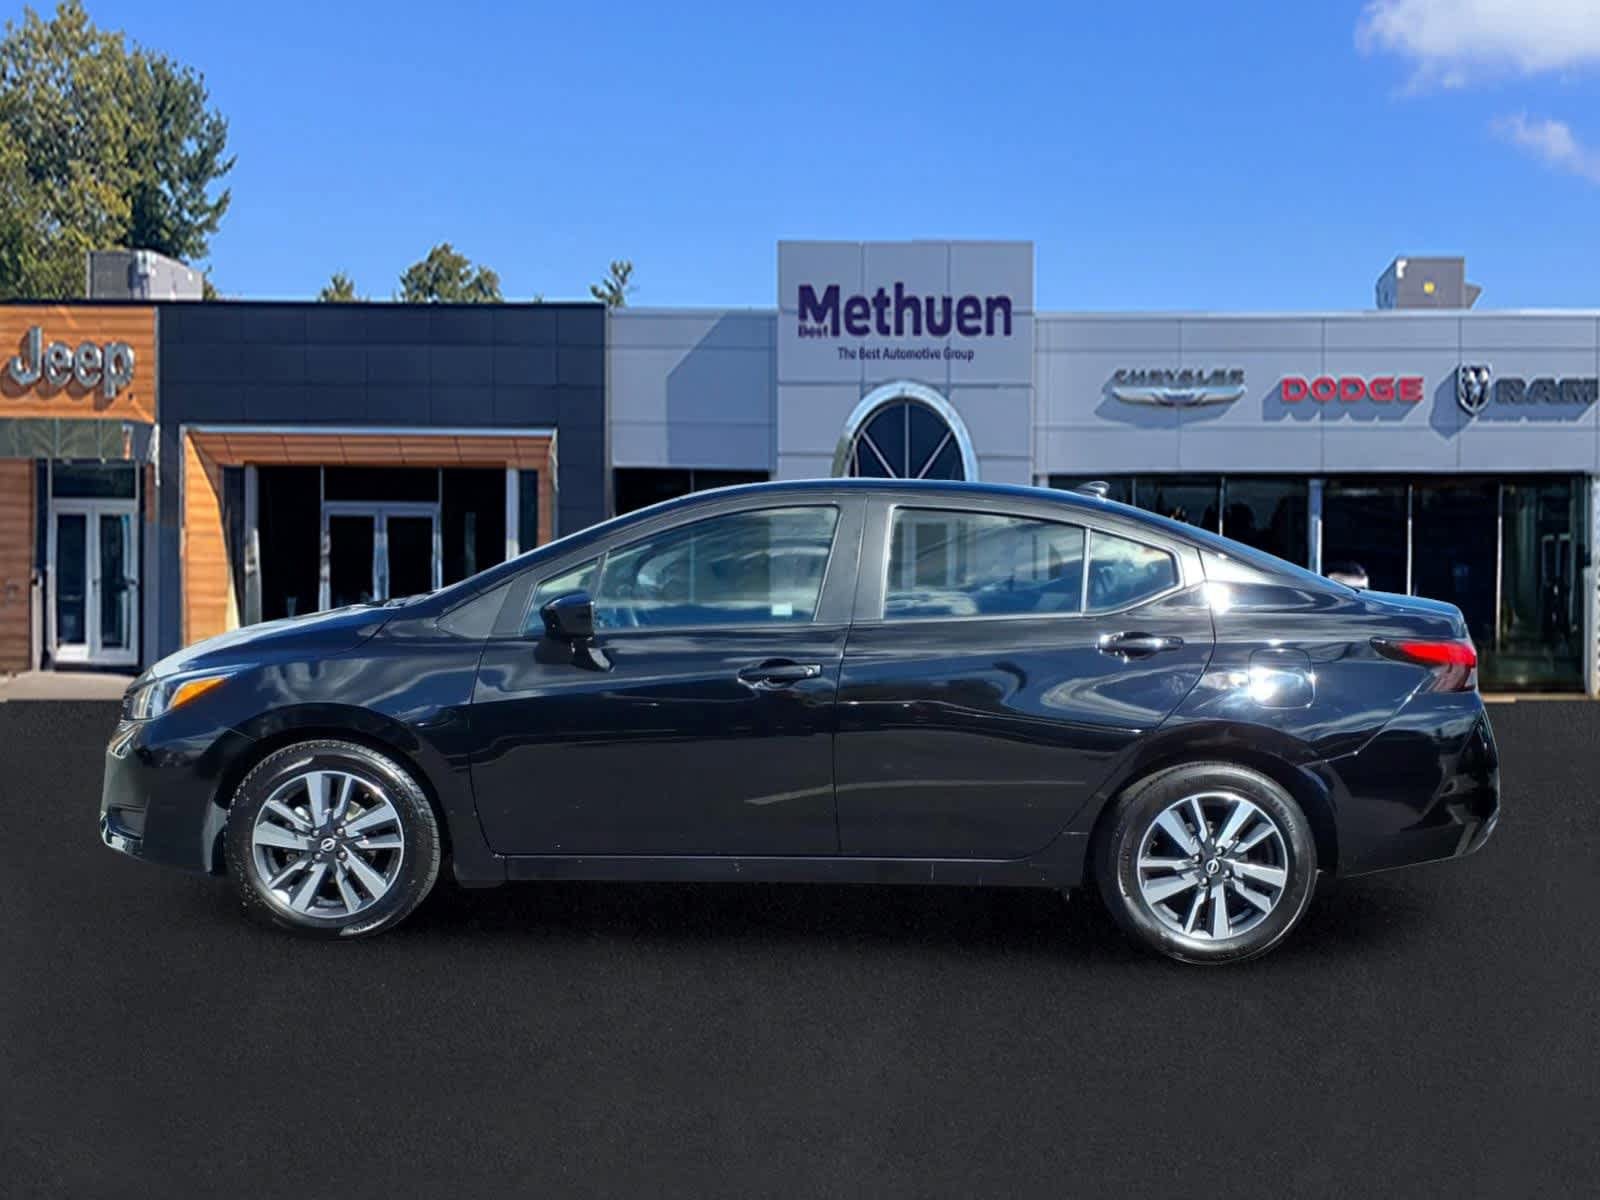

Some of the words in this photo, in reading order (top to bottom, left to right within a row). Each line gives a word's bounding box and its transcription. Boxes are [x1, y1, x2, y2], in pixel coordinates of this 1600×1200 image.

[798, 282, 1012, 337] Methuen
[10, 326, 135, 399] Jeep
[838, 346, 857, 359] The
[859, 346, 880, 360] Best
[882, 346, 940, 360] Automotive
[943, 346, 974, 363] Group
[1114, 369, 1245, 384] CHRYSLER
[1281, 377, 1424, 401] DODGE
[1495, 377, 1599, 404] RAM
